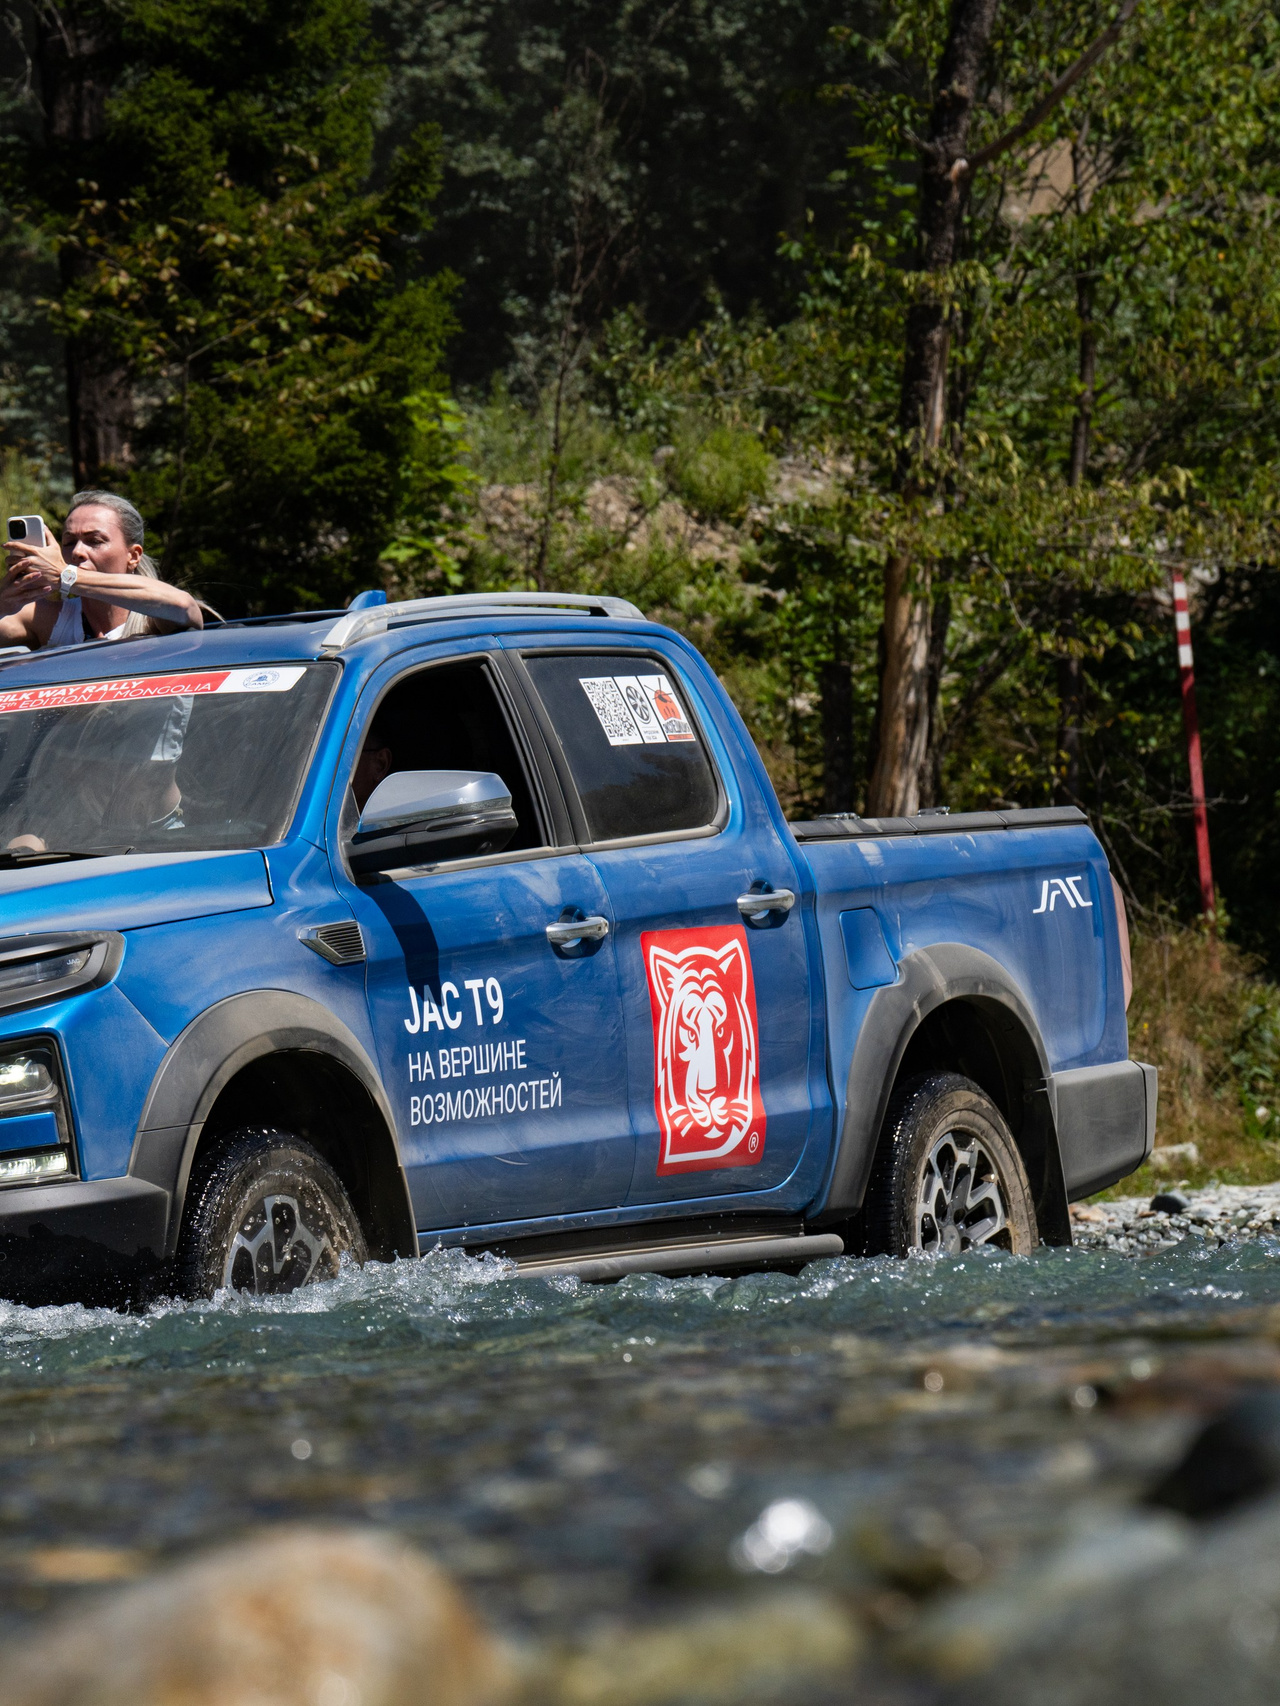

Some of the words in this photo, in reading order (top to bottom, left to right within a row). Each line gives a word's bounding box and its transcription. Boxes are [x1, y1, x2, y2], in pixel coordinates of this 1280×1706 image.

[19, 694, 93, 709] EDITION
[113, 683, 212, 699] MONGOLIA
[37, 686, 81, 699] WAY
[82, 680, 144, 694] RALLY
[1032, 875, 1093, 914] JAC
[404, 981, 463, 1034] JAC
[464, 976, 504, 1026] T9
[408, 1051, 436, 1083] НА
[438, 1039, 528, 1079] ВЕРШИНЕ
[410, 1071, 562, 1126] ВОЗМОЖНОСТЕЙ
